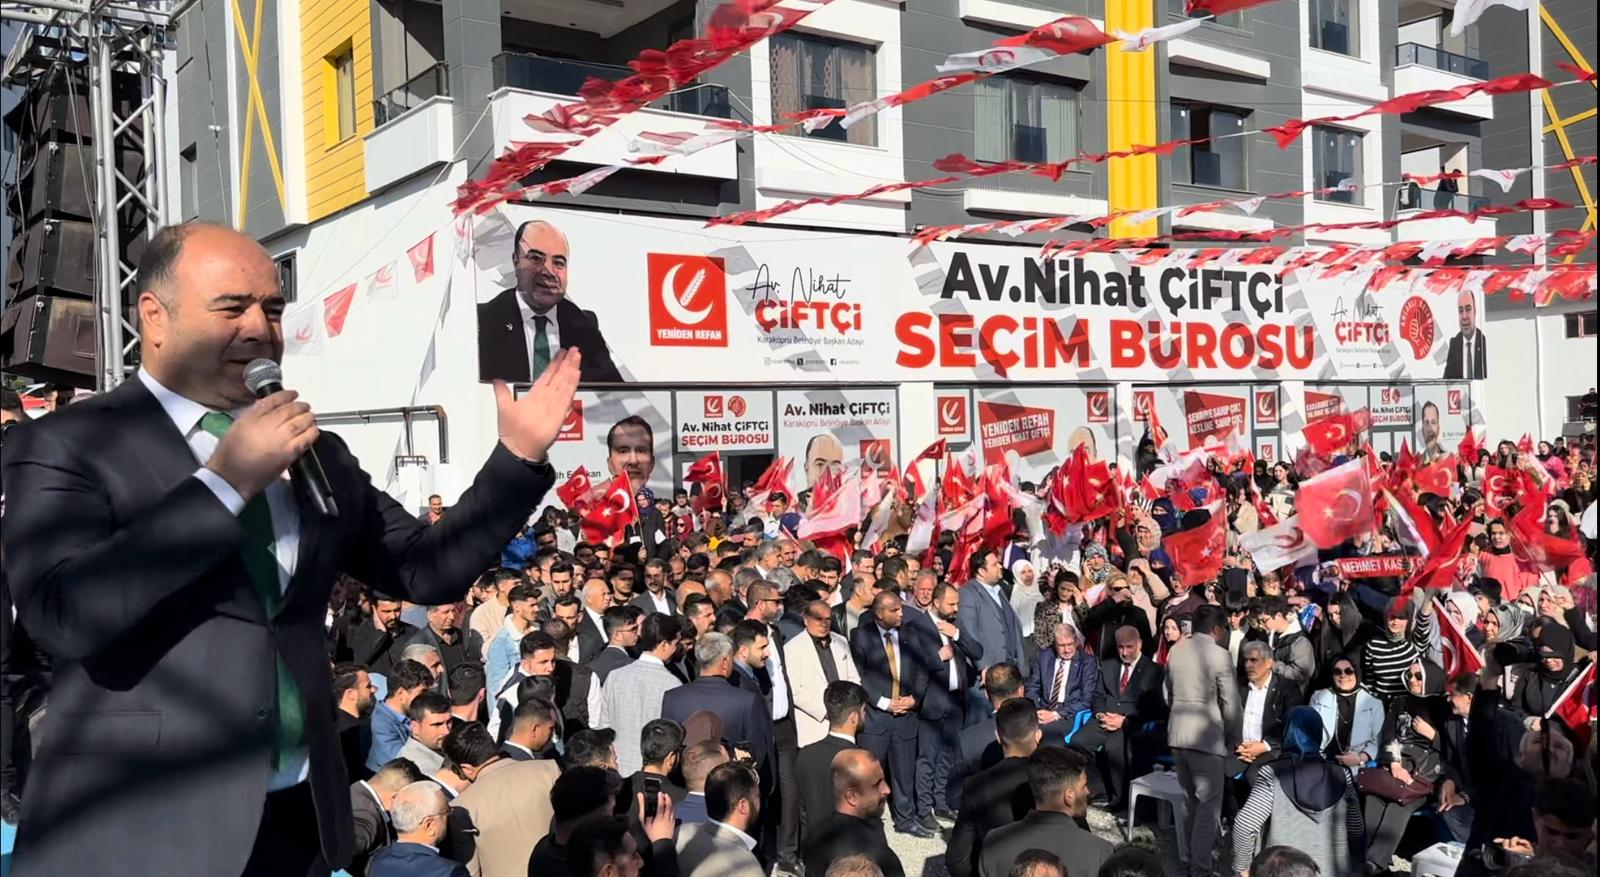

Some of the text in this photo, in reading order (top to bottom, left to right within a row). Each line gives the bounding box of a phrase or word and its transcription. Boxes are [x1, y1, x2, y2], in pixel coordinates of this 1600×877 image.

[790, 266, 852, 304] Nihat
[694, 329, 722, 340] REFAH
[1110, 319, 1315, 370] BÜROSU
[784, 403, 806, 416] Av.
[809, 402, 846, 416] Nihat
[682, 422, 700, 432] Av.
[702, 421, 732, 432] Nihat
[1021, 412, 1050, 430] REFAH
[721, 433, 769, 445] BÜROSU
[1341, 559, 1381, 573] MEHMET
